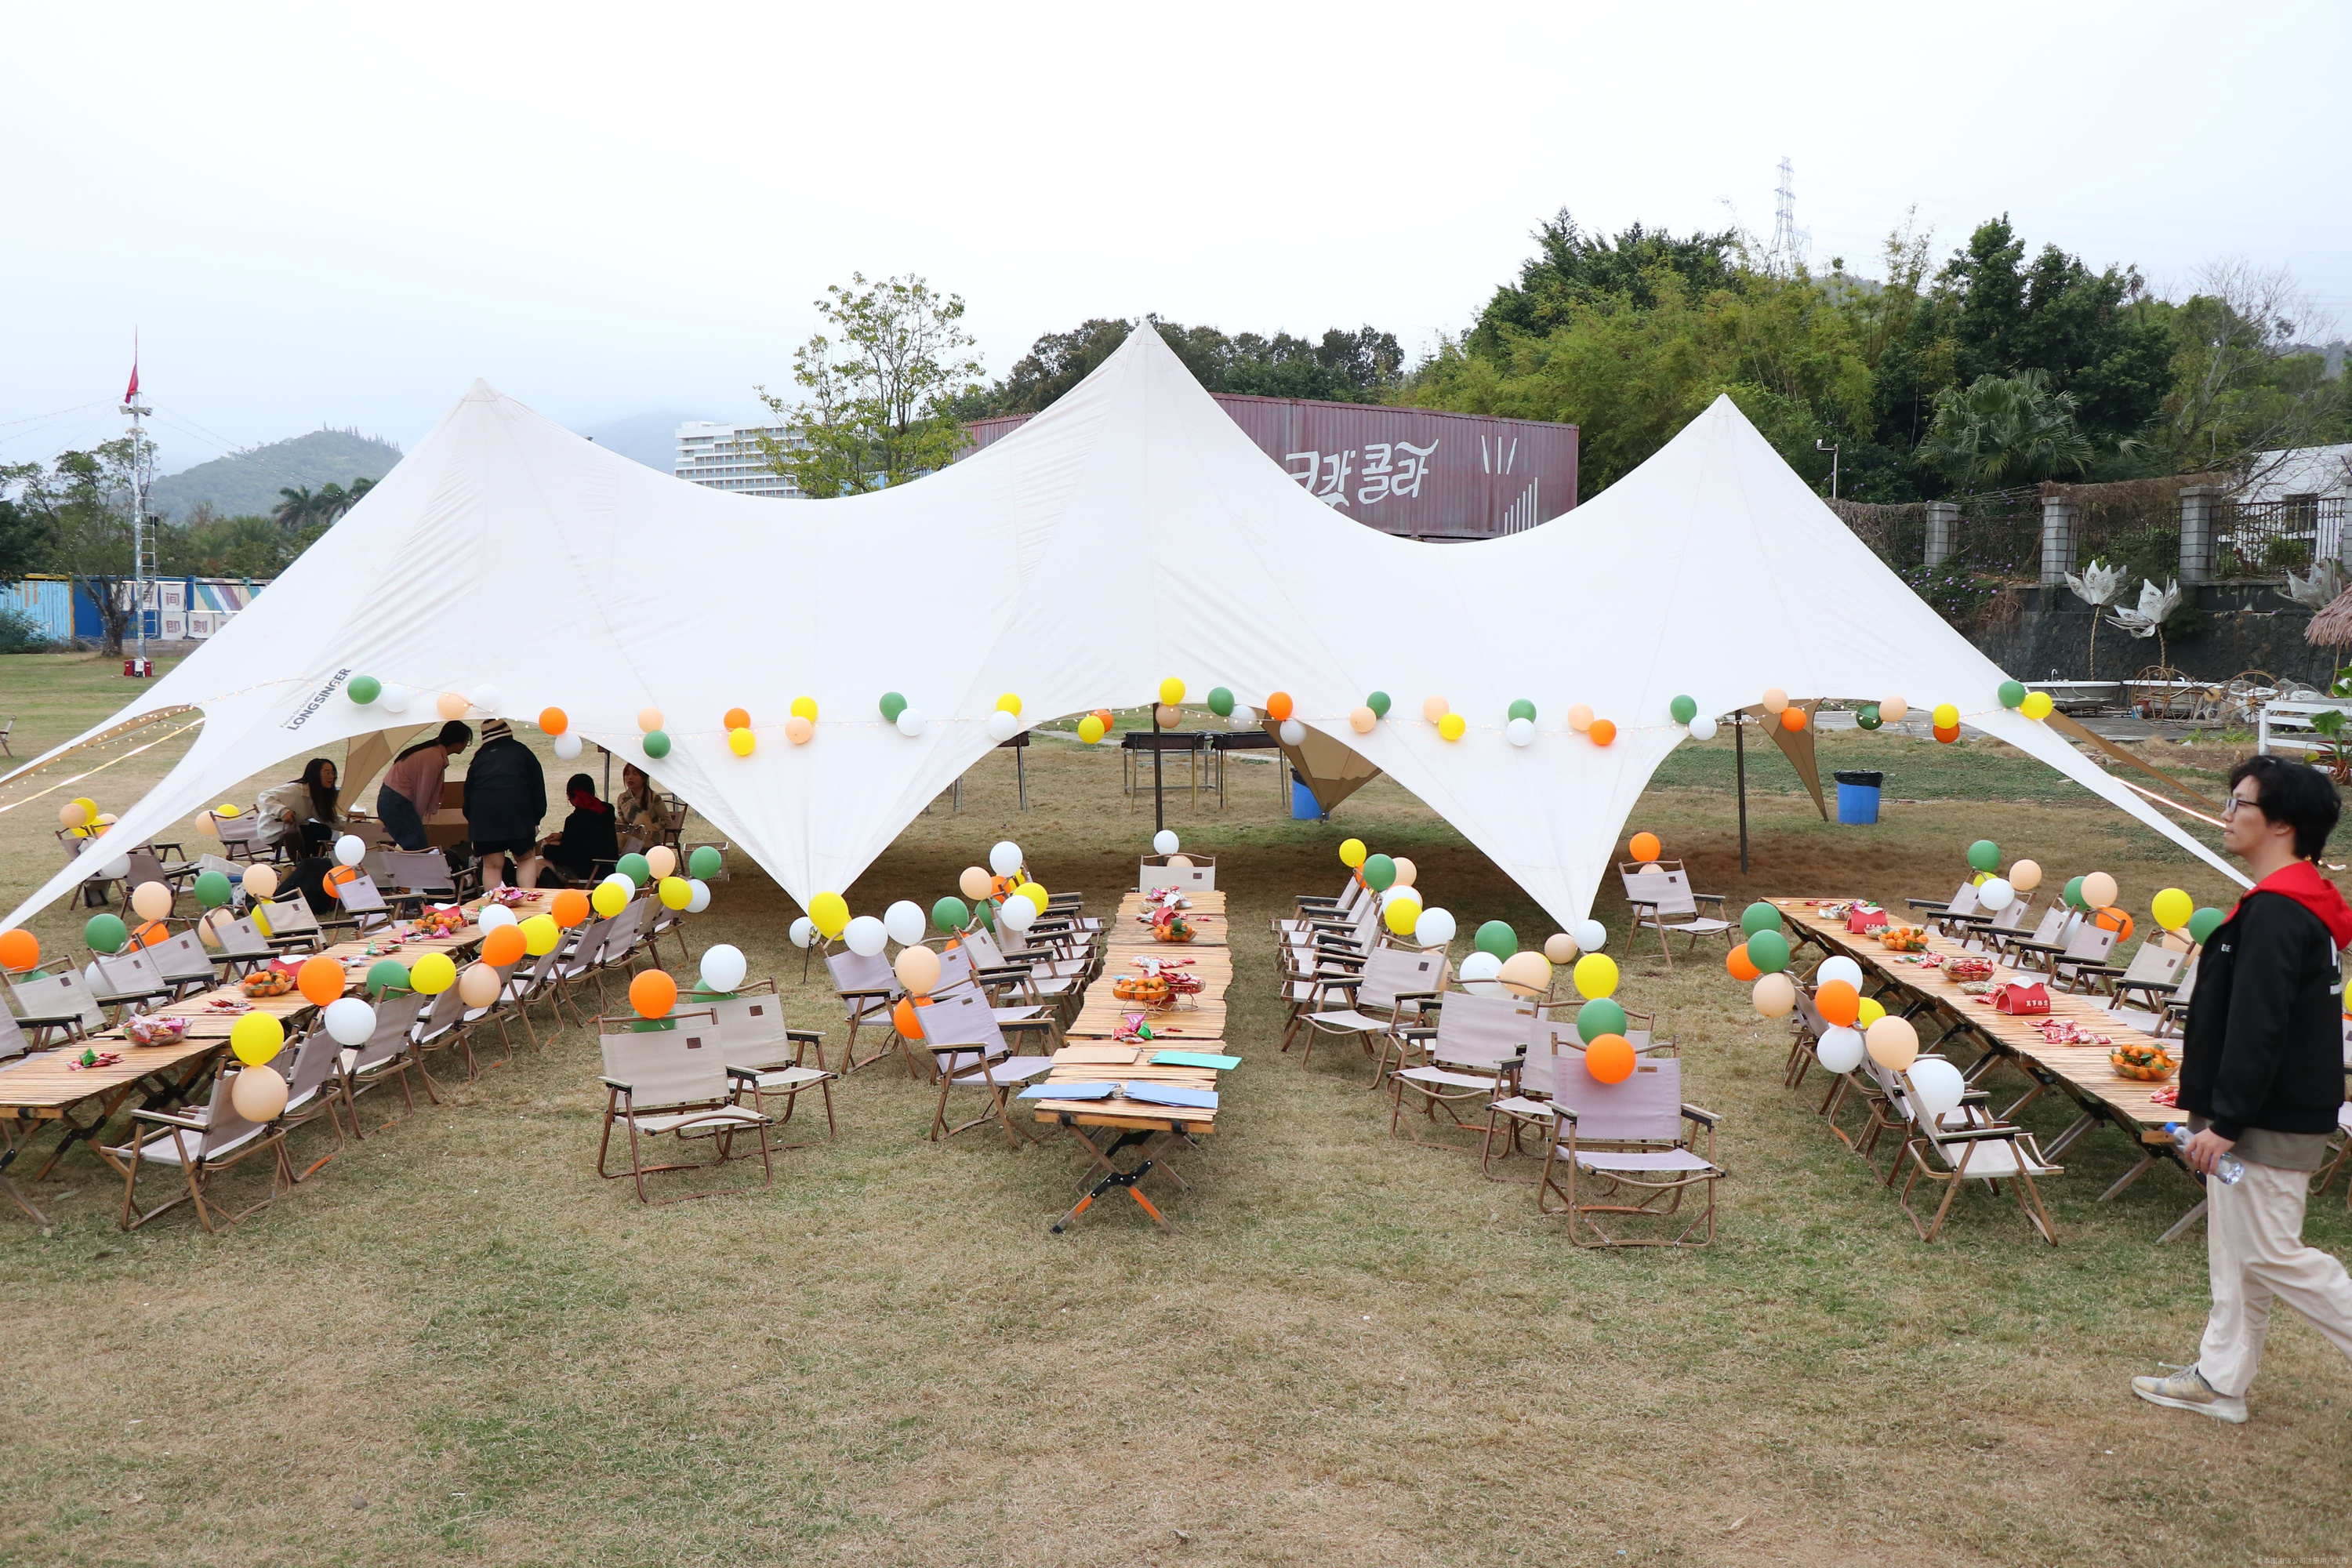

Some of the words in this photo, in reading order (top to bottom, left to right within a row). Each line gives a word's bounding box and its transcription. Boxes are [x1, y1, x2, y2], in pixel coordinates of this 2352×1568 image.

[166, 620, 227, 633] 即刻
[279, 715, 296, 728] Focus
[299, 691, 318, 708] Outdoor
[286, 668, 352, 731] LONGSINGER
